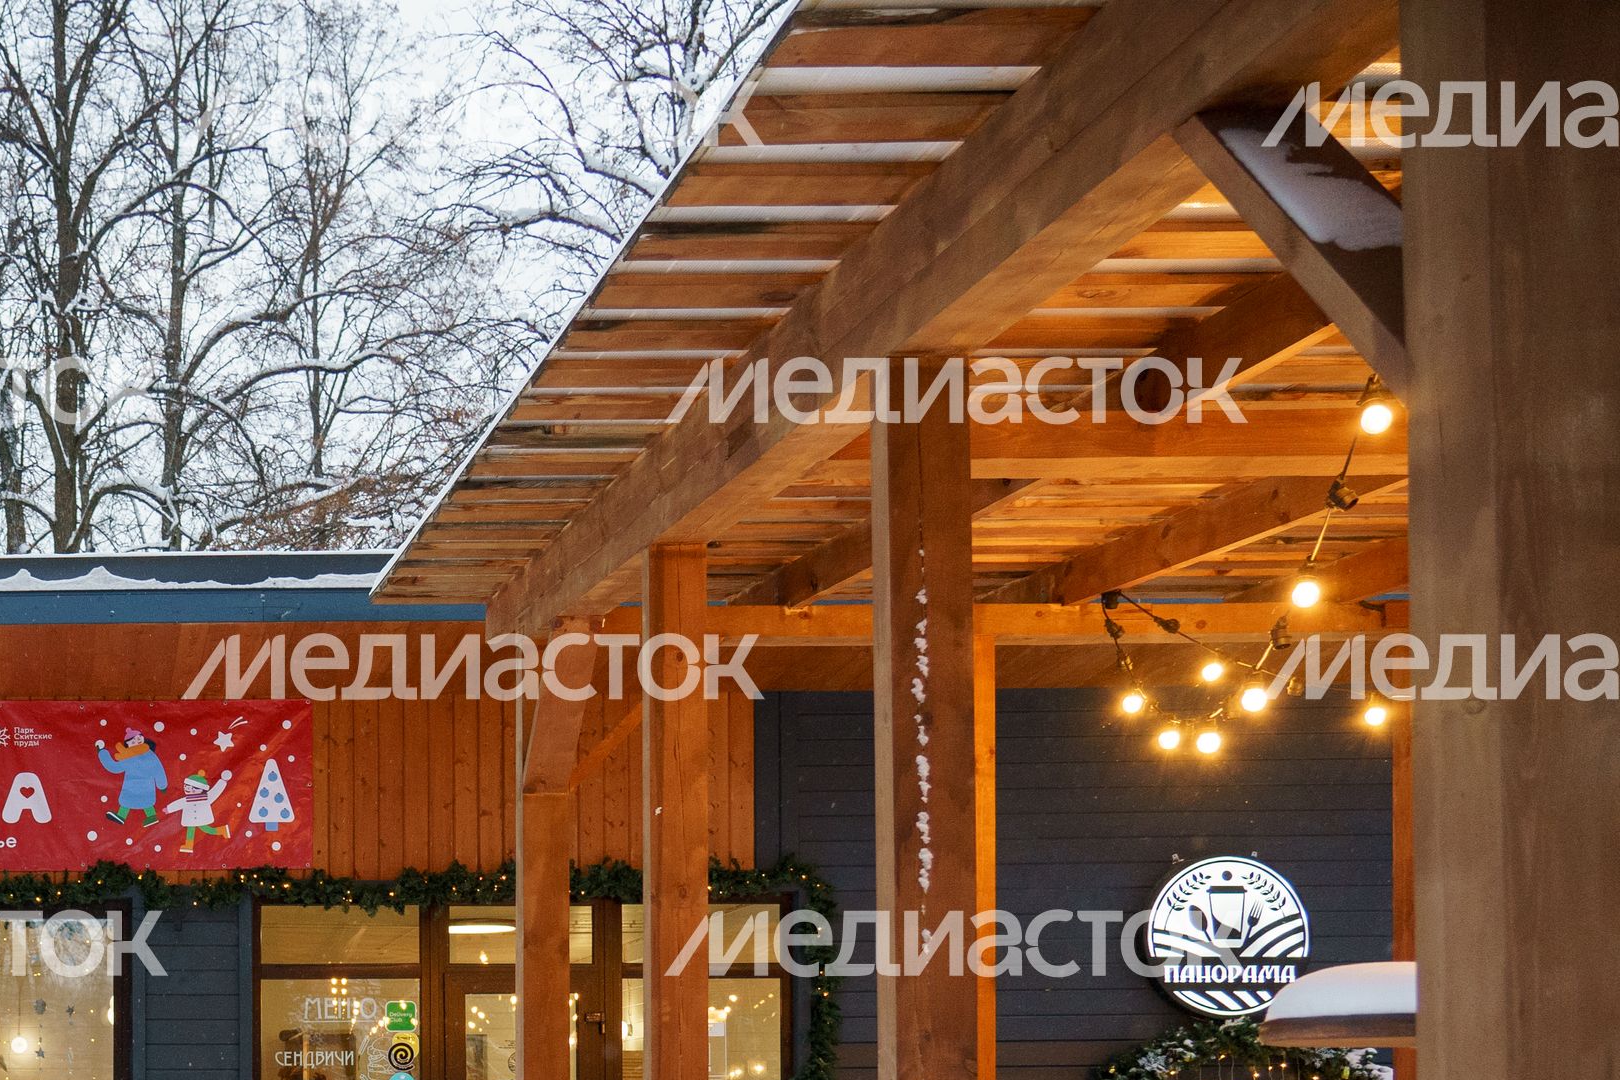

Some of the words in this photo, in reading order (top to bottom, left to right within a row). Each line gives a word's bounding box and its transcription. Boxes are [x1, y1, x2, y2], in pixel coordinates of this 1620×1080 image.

[14, 726, 35, 735] Парк
[14, 732, 53, 740] Скитские
[14, 740, 40, 748] пруды
[1164, 965, 1297, 983] ПАНОРАМА
[275, 1051, 354, 1067] СЕНДВИЧИ
